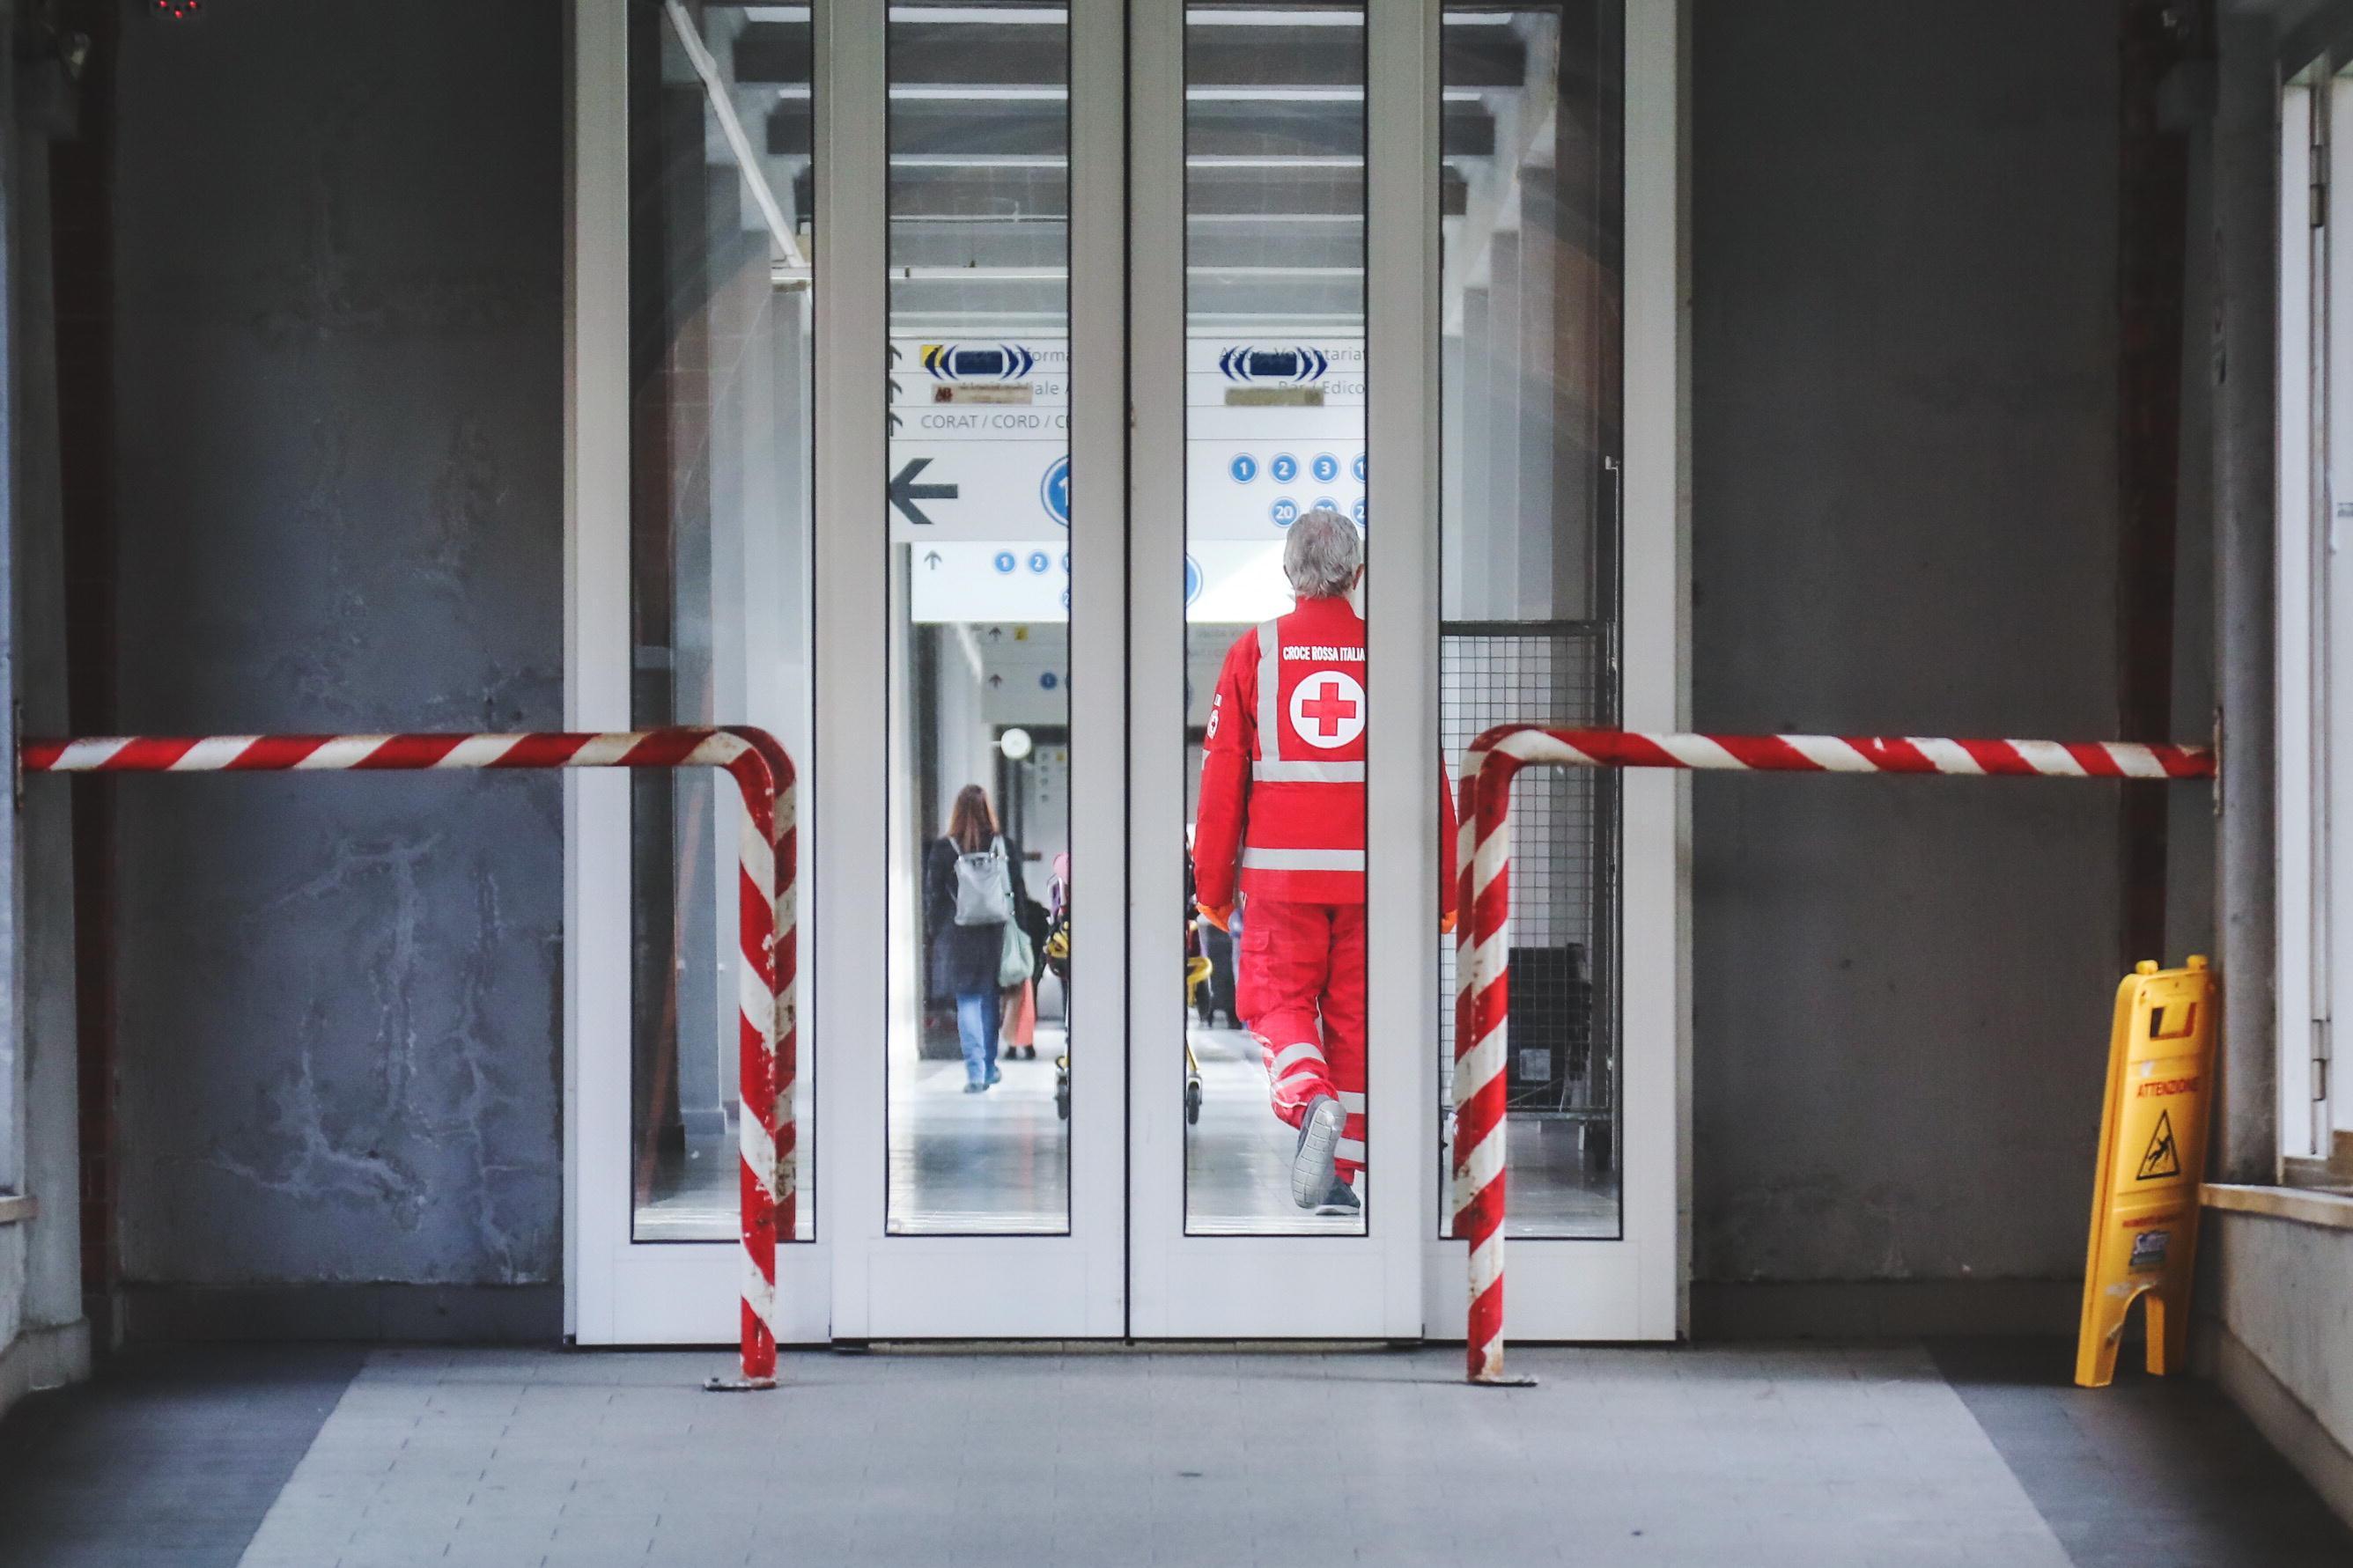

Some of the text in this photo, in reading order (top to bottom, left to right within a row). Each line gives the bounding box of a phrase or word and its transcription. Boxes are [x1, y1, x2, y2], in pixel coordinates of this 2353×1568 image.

[921, 414, 1069, 430] CORAT / CORD / C
[1239, 461, 1247, 475] 1
[1279, 461, 1289, 475] 2
[1321, 461, 1331, 475] 3
[1275, 505, 1365, 520] 20 2
[1000, 556, 1008, 569] 1
[1034, 556, 1043, 569] 2
[1283, 645, 1310, 660] CROCE
[1311, 645, 1339, 661] ROSSA
